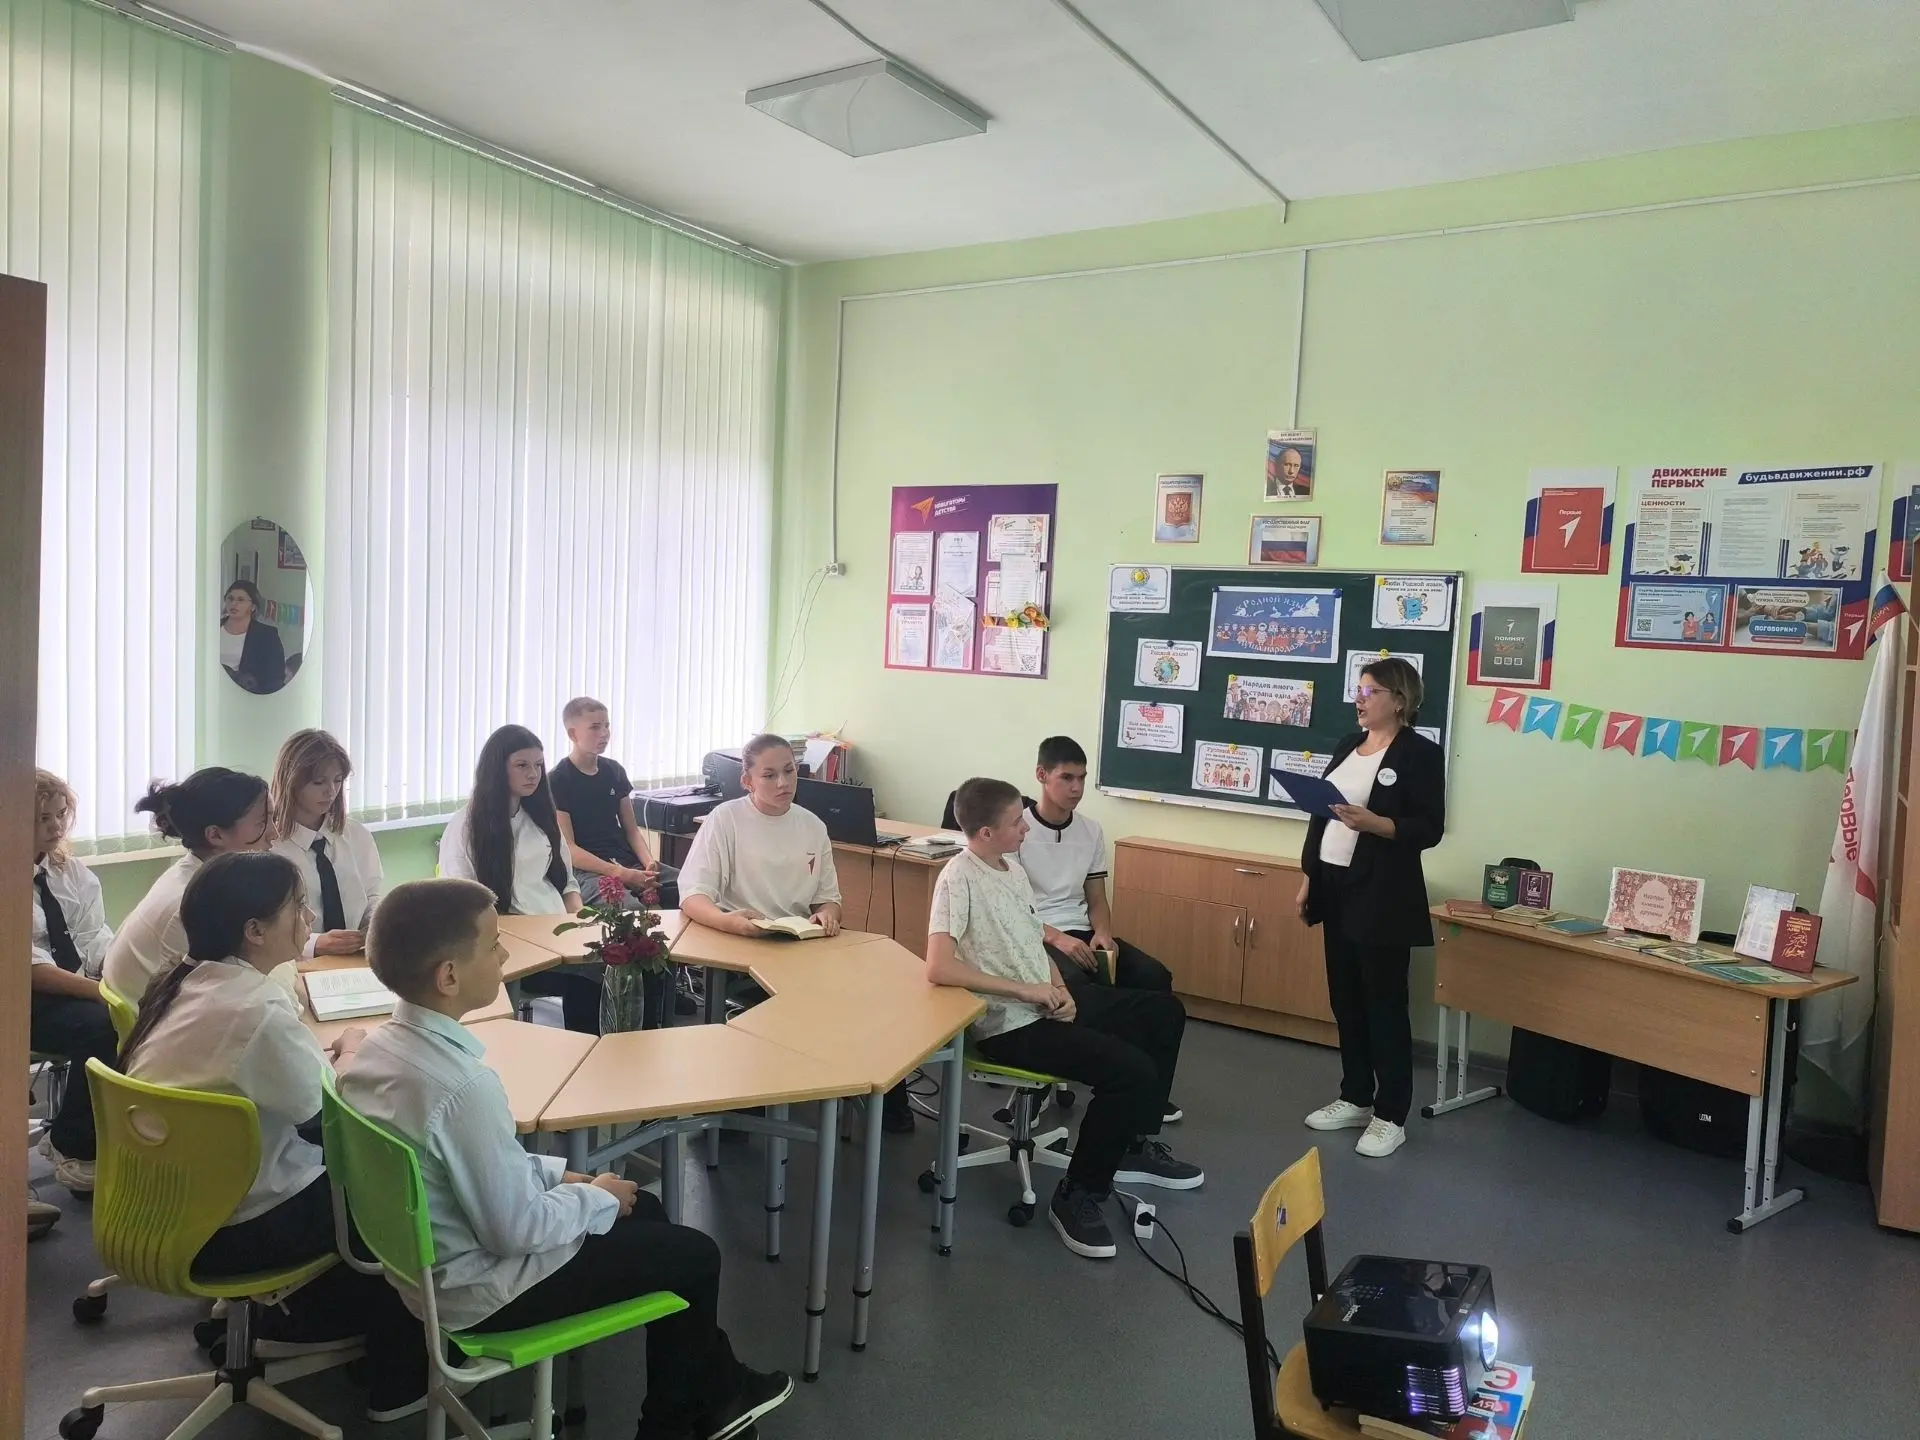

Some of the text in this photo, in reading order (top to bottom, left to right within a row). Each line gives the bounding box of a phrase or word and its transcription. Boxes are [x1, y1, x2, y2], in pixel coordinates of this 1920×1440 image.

[1652, 468, 1728, 478] ДВИЖЕНИЕ
[1745, 466, 1866, 483] будьвдвижении.рф
[1651, 478, 1705, 488] ПЕРВЫХ
[1242, 680, 1271, 689] Народов
